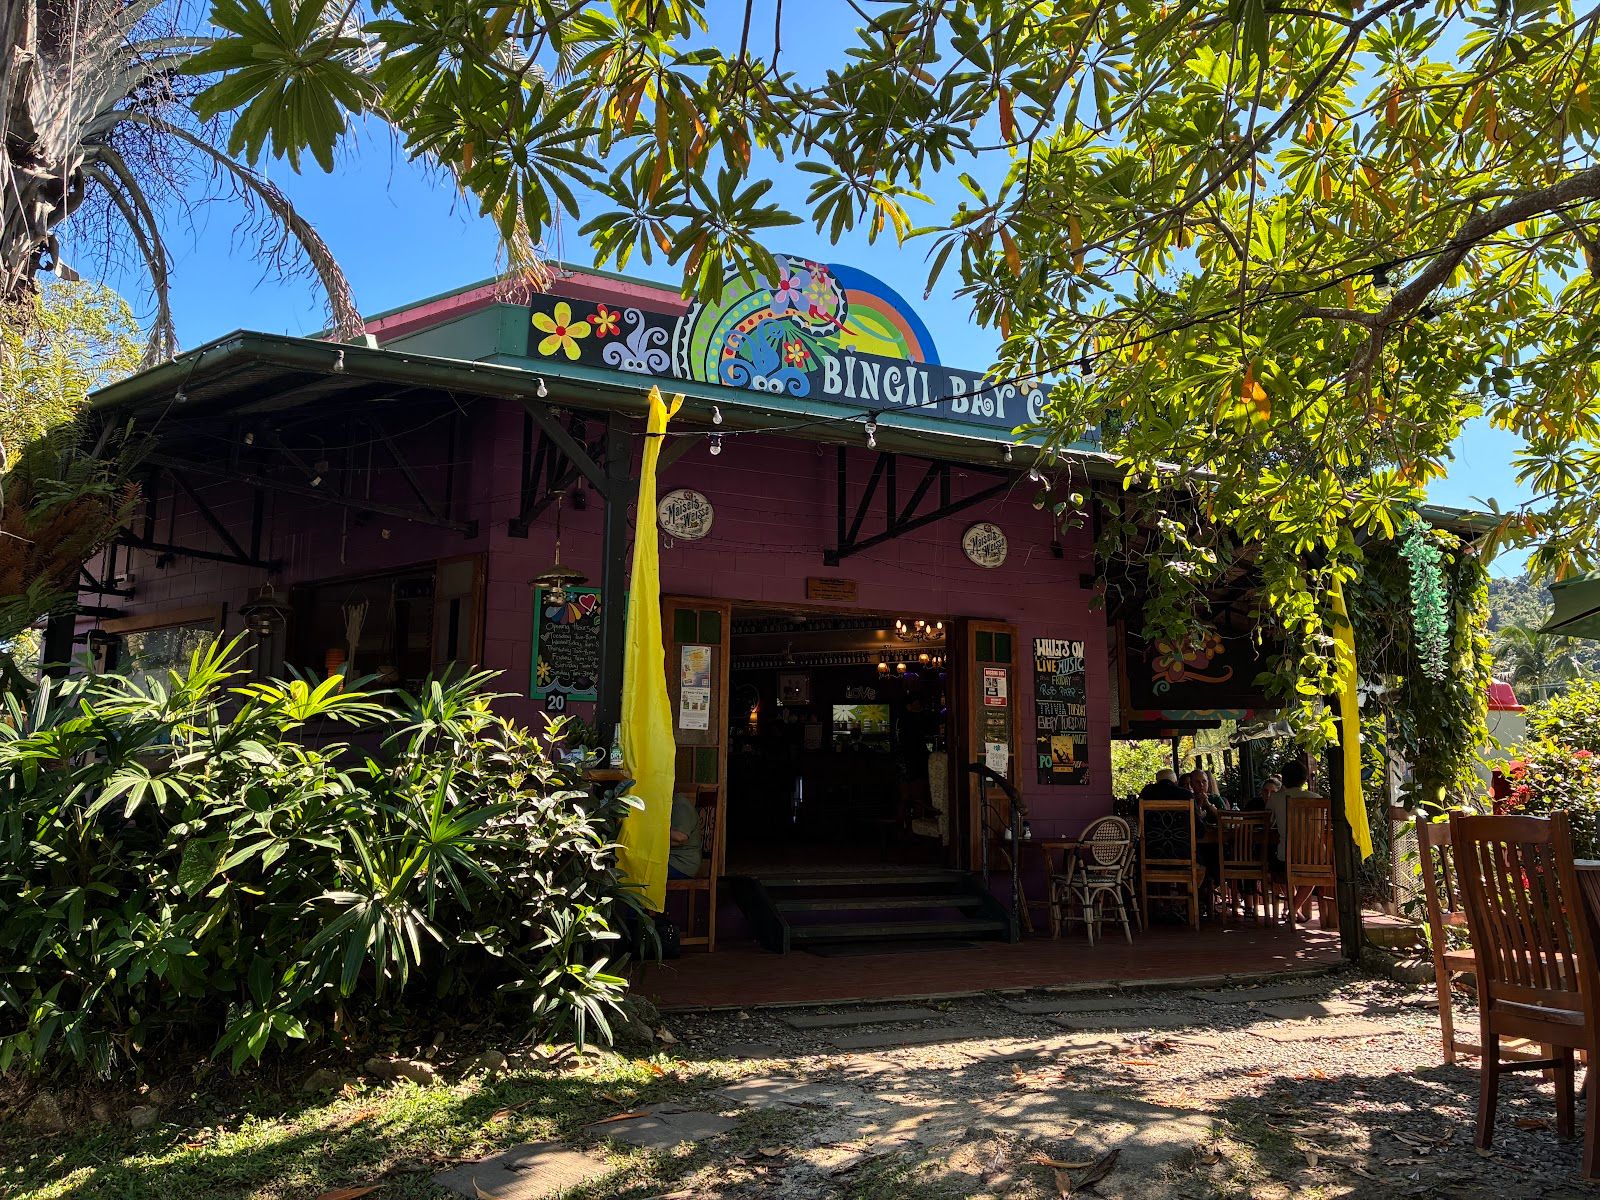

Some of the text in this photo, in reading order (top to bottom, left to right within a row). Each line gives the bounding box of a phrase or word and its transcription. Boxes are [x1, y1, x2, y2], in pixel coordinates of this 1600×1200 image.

[823, 355, 937, 409] BINGIL
[949, 375, 1015, 419] BAY
[1071, 641, 1085, 659] ON
[1056, 657, 1085, 676] MUSIC
[1052, 676, 1071, 686] FRIDAY
[547, 695, 565, 710] 20
